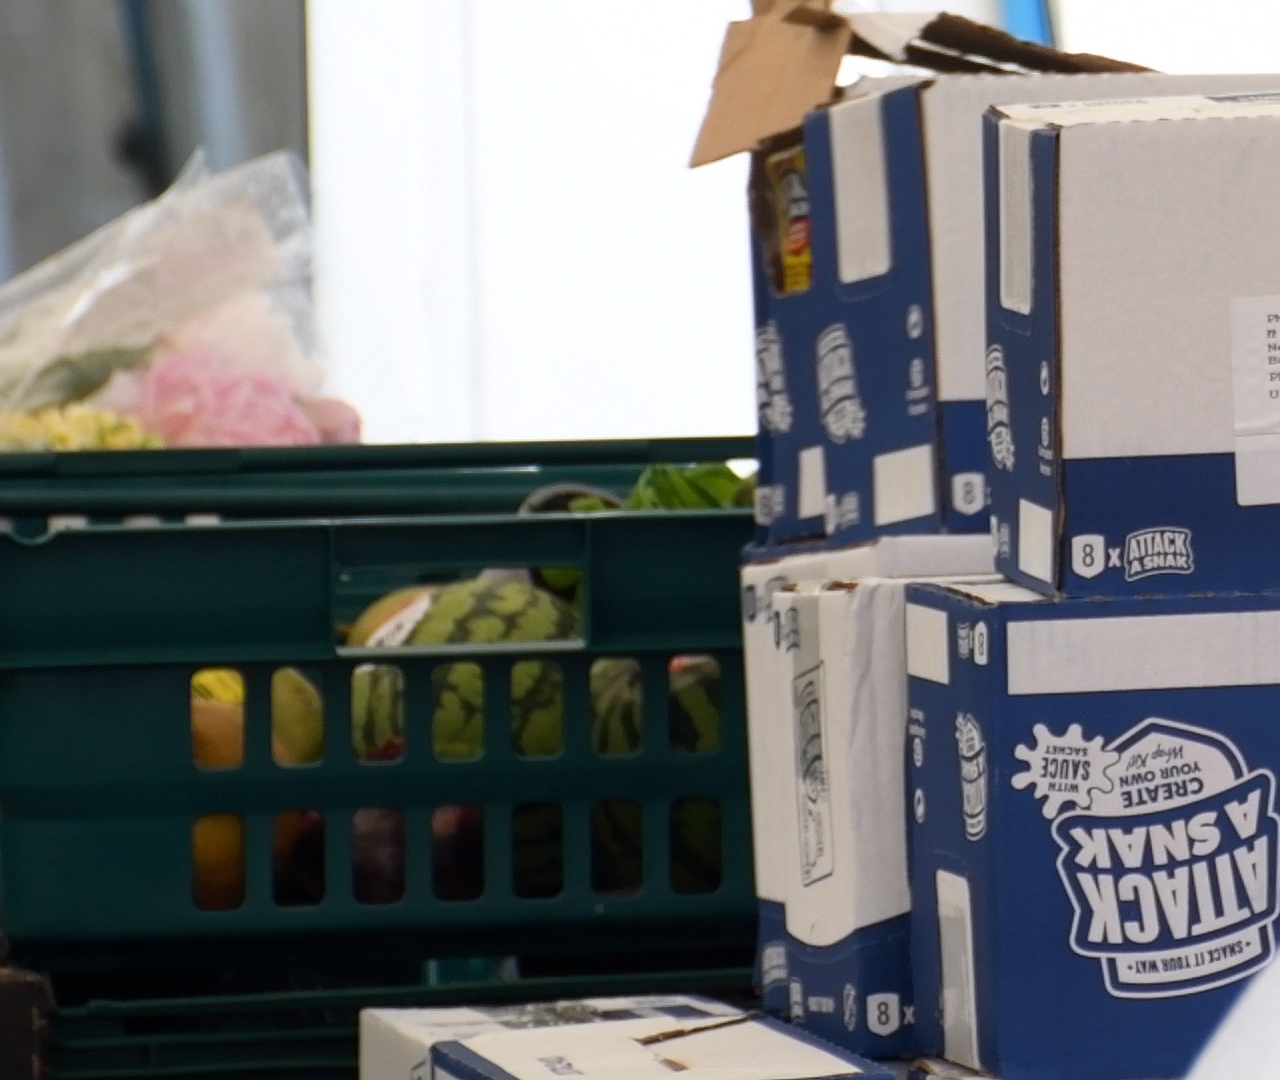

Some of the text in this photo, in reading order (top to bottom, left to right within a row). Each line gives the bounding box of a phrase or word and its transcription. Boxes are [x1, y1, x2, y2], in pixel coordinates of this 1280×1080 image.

[1082, 543, 1095, 568] 8
[1129, 531, 1187, 560] ATTACK
[1129, 554, 1188, 575] A SNAK
[1044, 745, 1088, 757] SACHET
[1040, 757, 1091, 781] SAUCE
[1119, 761, 1202, 788] YOUR OWN
[1048, 782, 1079, 793] WITH
[1121, 777, 1204, 808] CREATE
[1069, 788, 1262, 869] A SNAK
[1076, 835, 1268, 944] ATTACK
[1135, 940, 1244, 975] SNACK IT YOUR WAY
[878, 1001, 890, 1026] 8
